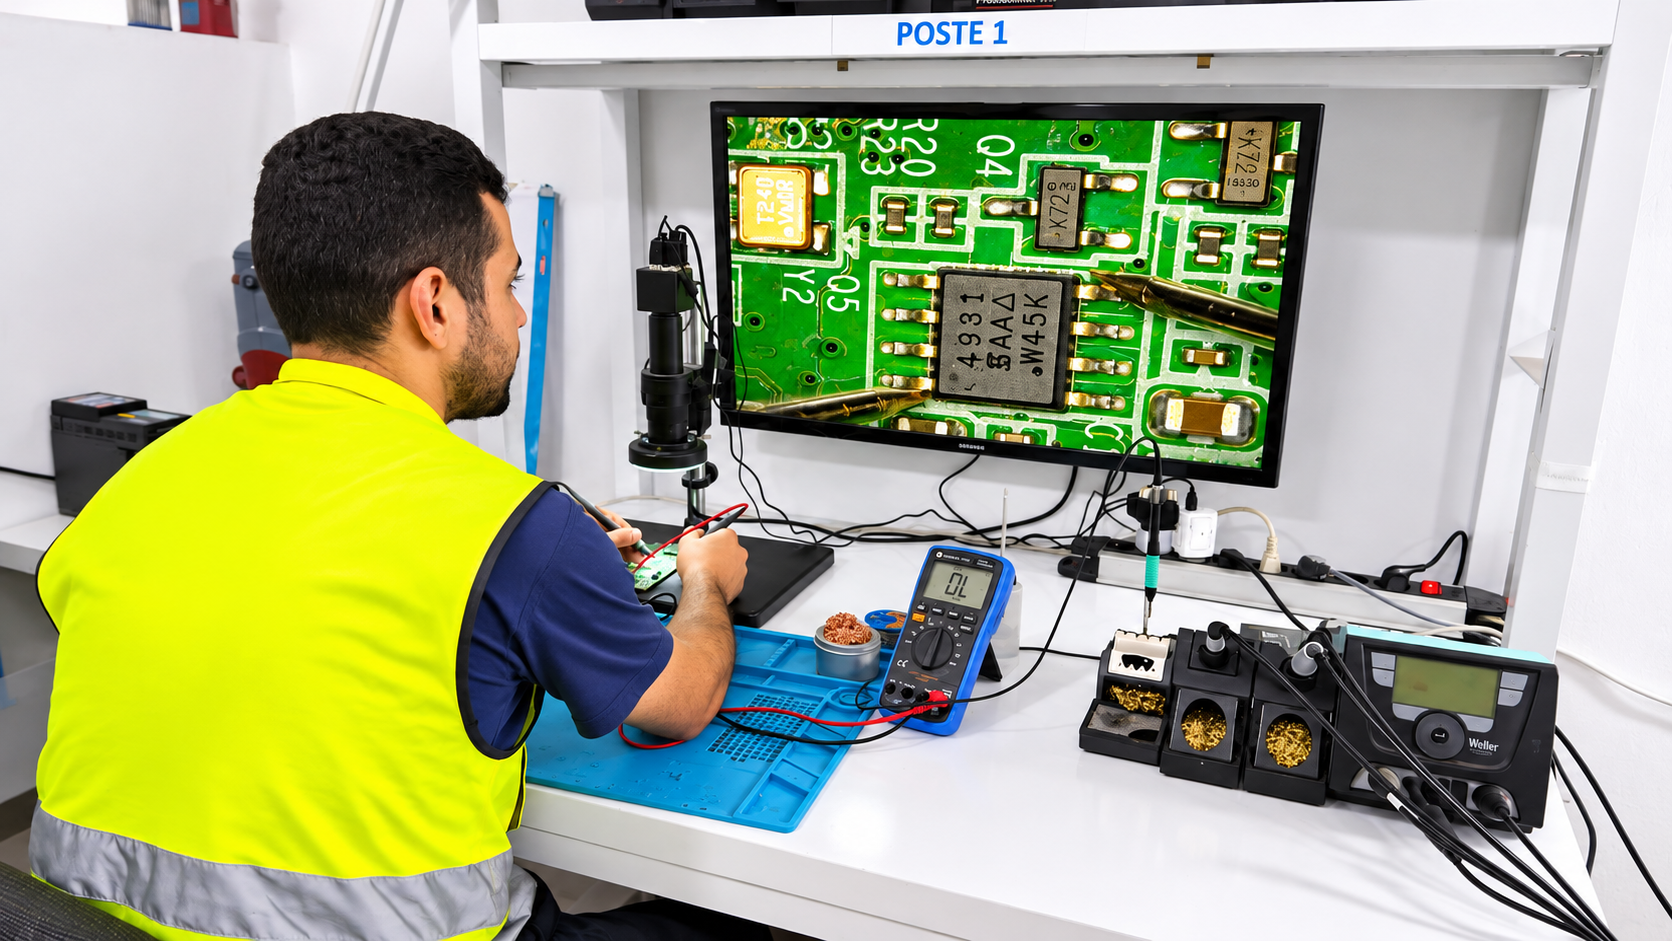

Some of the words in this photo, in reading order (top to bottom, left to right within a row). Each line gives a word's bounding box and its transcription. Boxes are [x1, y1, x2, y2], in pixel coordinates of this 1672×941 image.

[897, 21, 984, 46] POSTE
[993, 20, 1008, 45] 1
[902, 118, 939, 177] R20
[976, 134, 1015, 177] Q4
[782, 269, 816, 304] Y2
[827, 275, 861, 312] Q5
[956, 293, 985, 369] 4931
[1468, 737, 1500, 752] Weller
